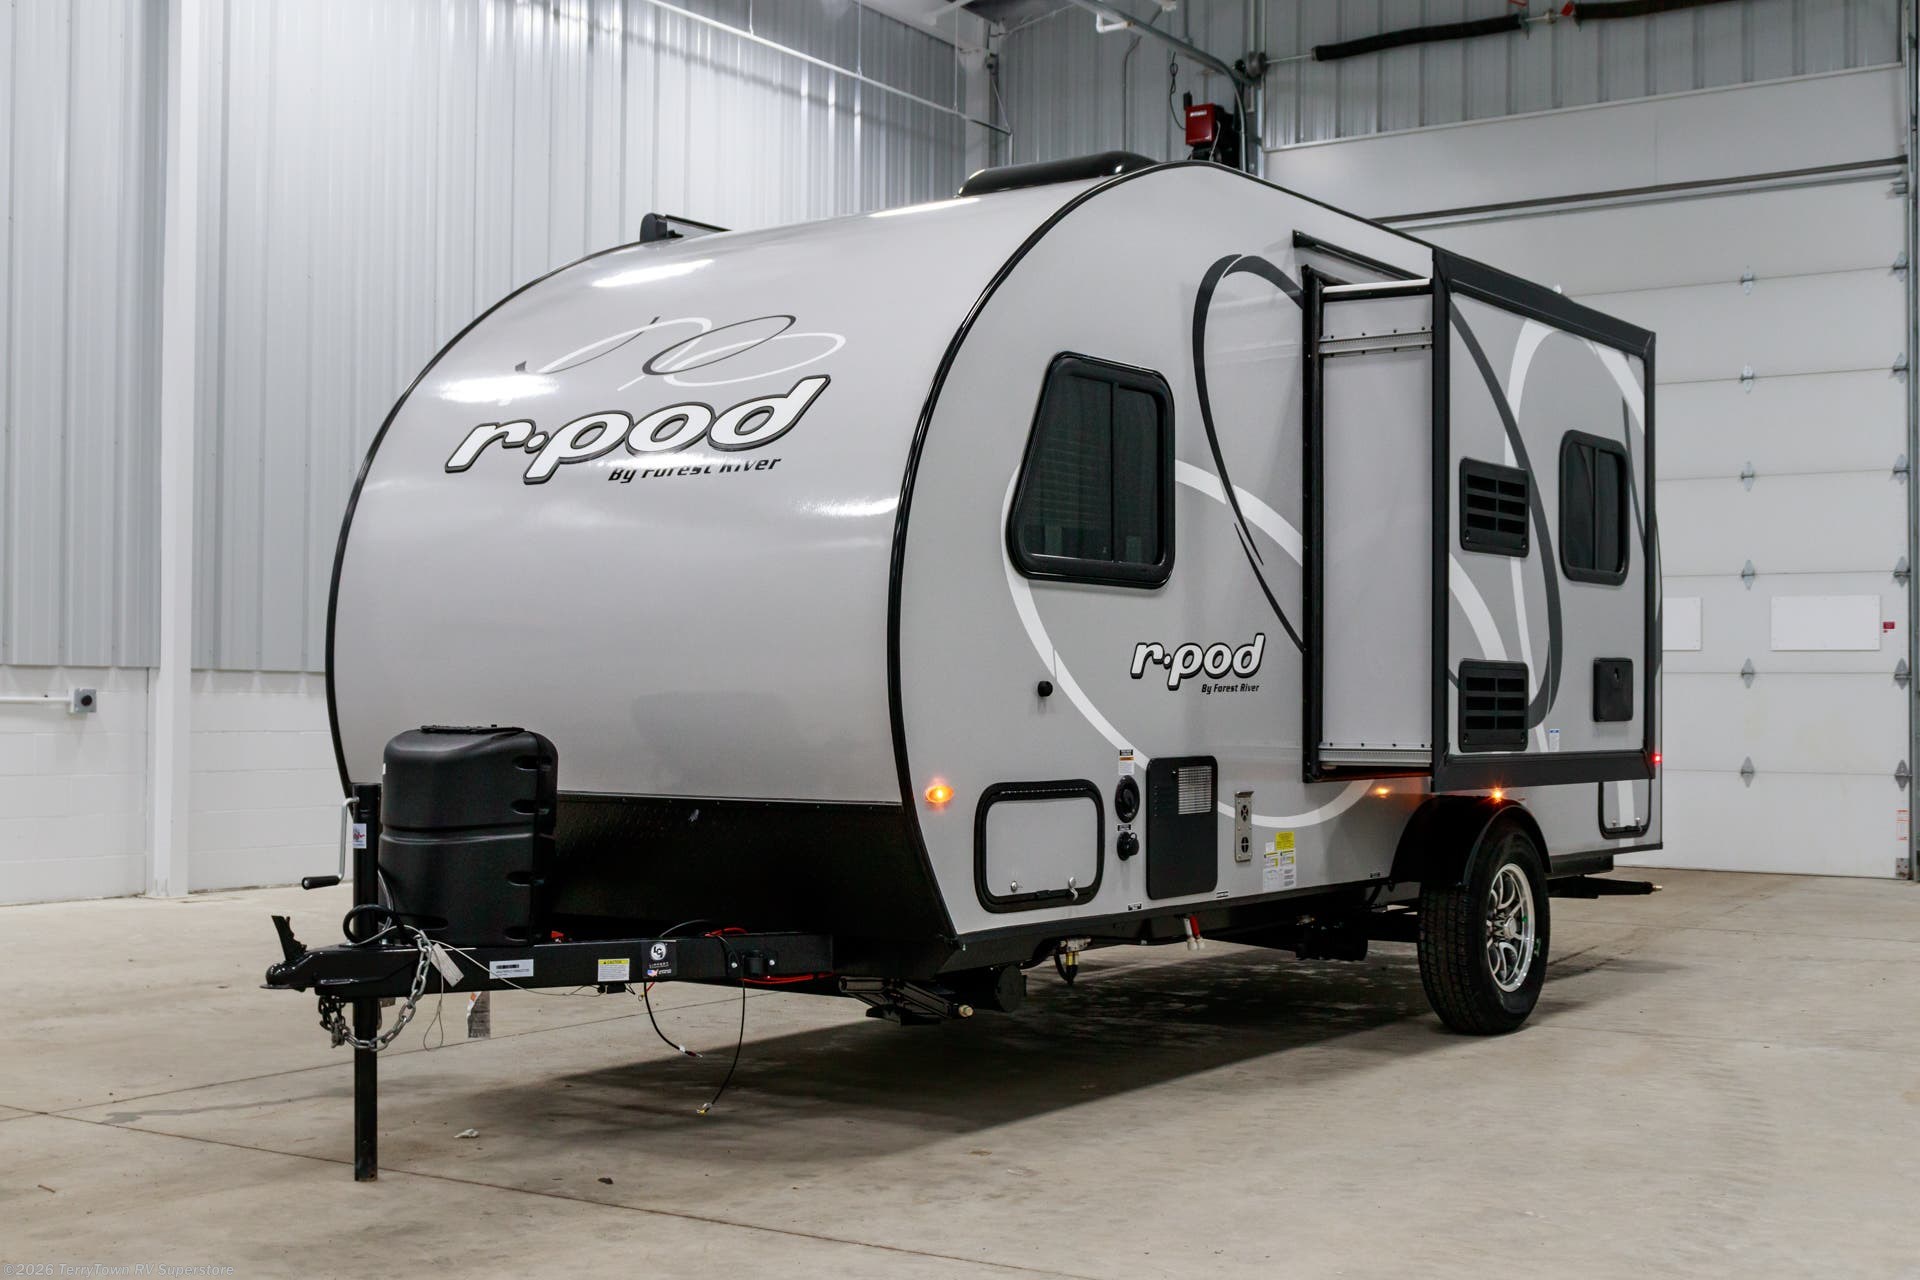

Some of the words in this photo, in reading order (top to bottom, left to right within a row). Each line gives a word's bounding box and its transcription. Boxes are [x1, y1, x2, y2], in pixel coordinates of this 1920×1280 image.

[608, 464, 637, 483] By
[1201, 683, 1212, 695] By
[1213, 683, 1239, 693] Forest
[1240, 683, 1260, 692] River
